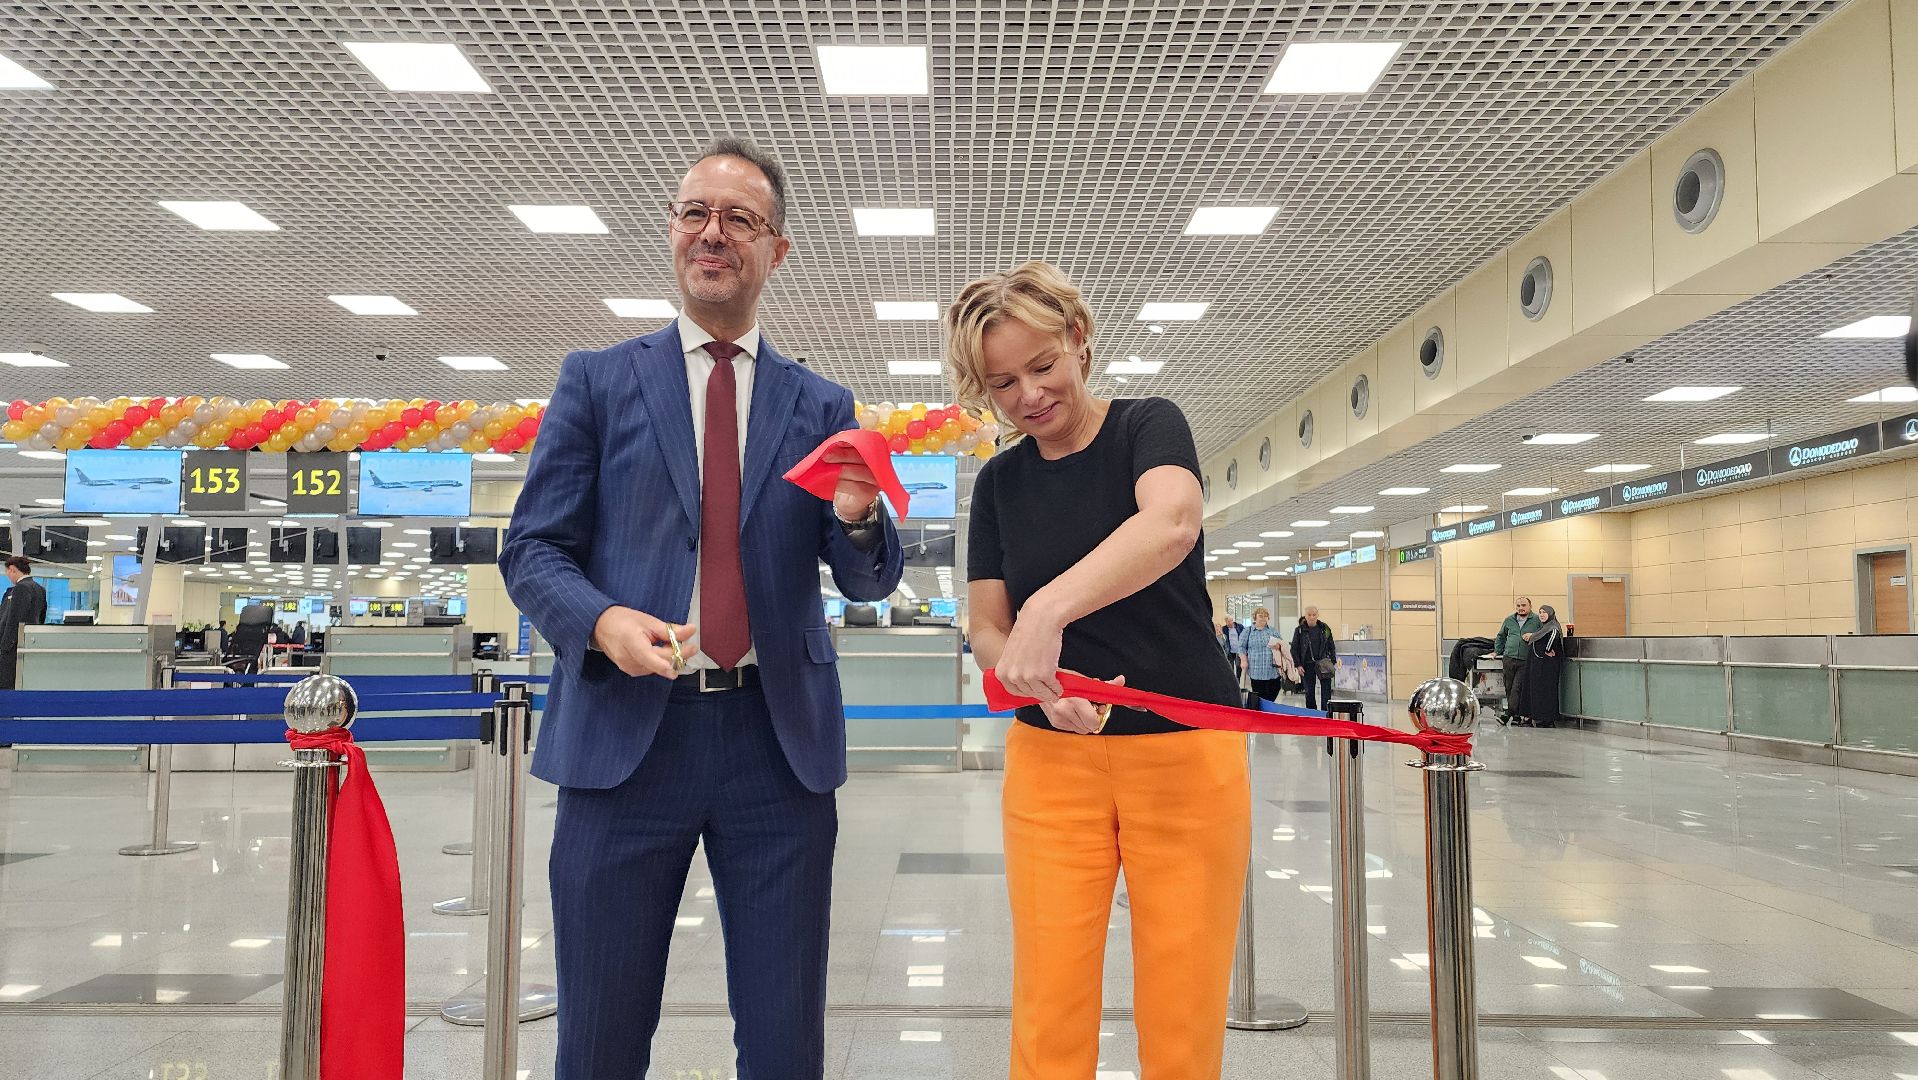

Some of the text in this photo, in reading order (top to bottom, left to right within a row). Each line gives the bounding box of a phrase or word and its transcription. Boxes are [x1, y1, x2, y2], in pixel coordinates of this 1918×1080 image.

[1801, 438, 1859, 460] DOMODEDOVO
[190, 468, 240, 494] 153
[292, 469, 341, 495] 152
